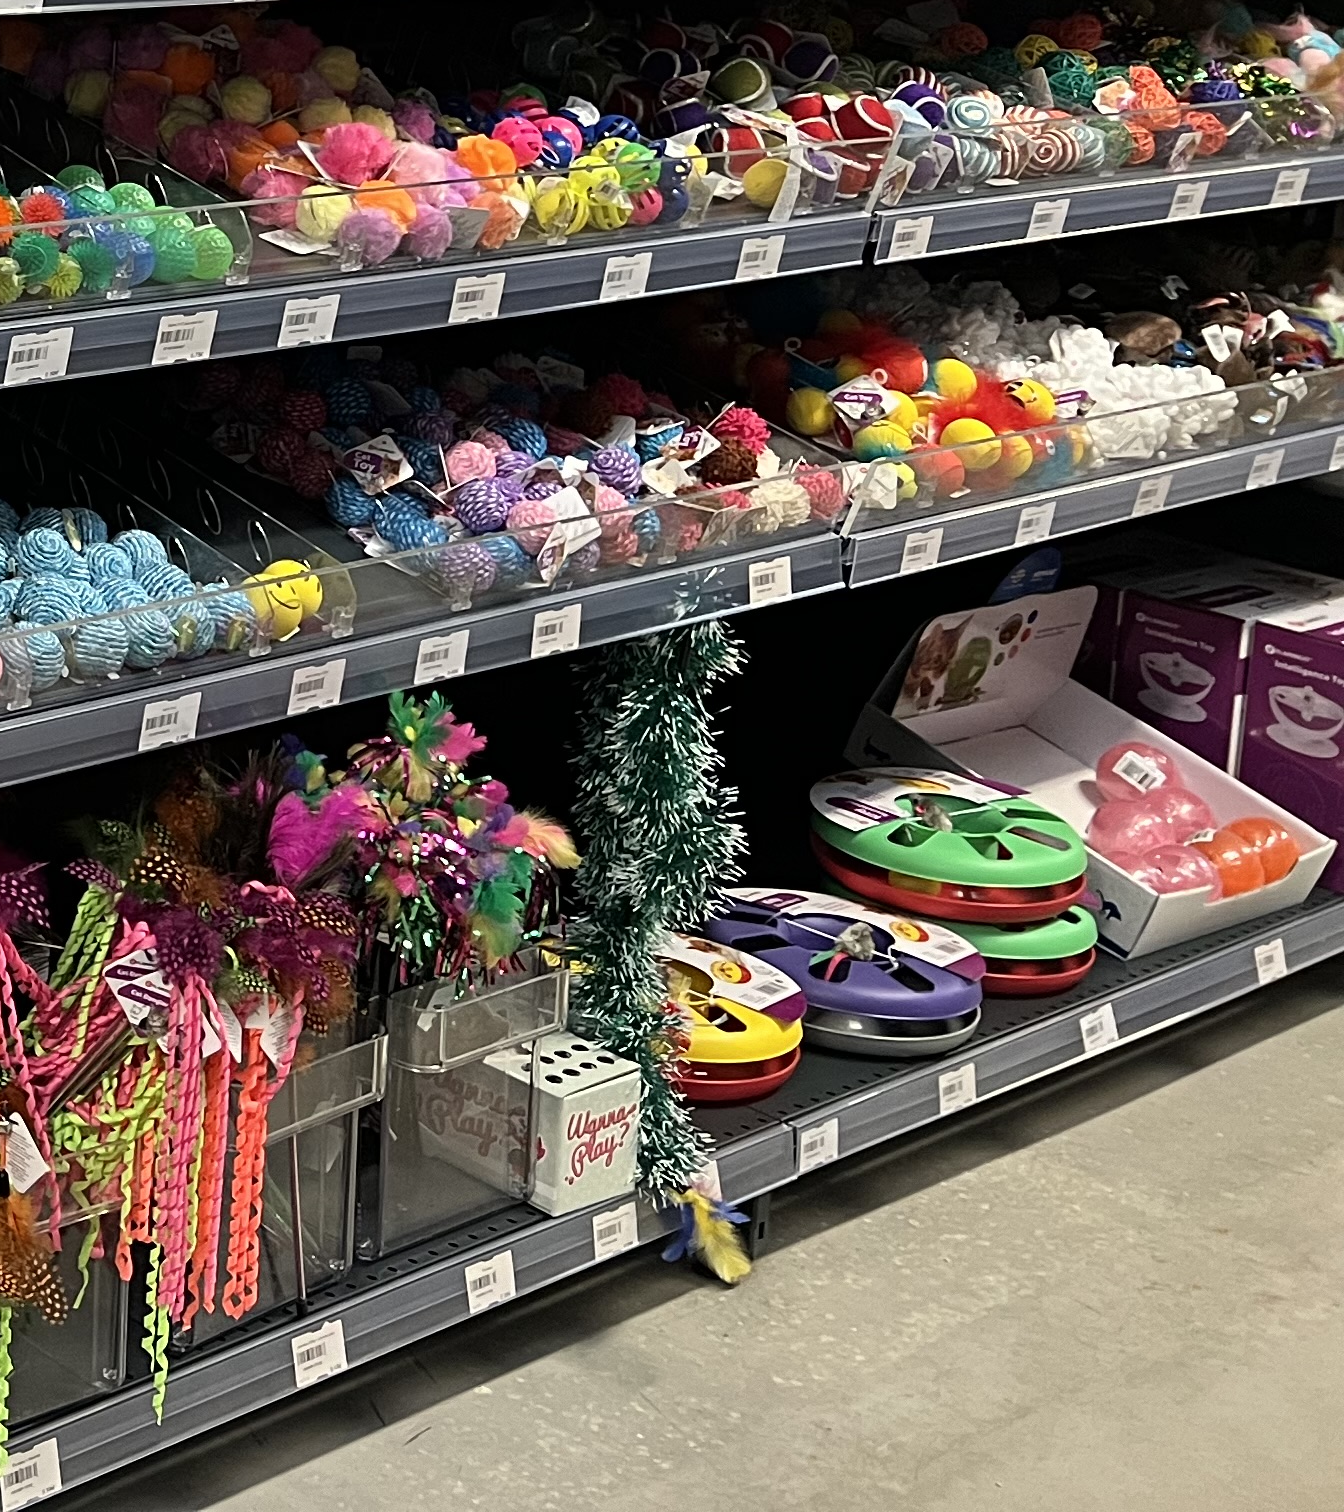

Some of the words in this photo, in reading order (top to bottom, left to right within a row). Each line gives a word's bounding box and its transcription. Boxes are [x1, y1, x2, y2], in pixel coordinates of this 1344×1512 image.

[354, 451, 371, 462] Cat
[354, 459, 375, 472] Toy
[568, 1104, 637, 1142] Wanna
[571, 1122, 631, 1178] Play?
